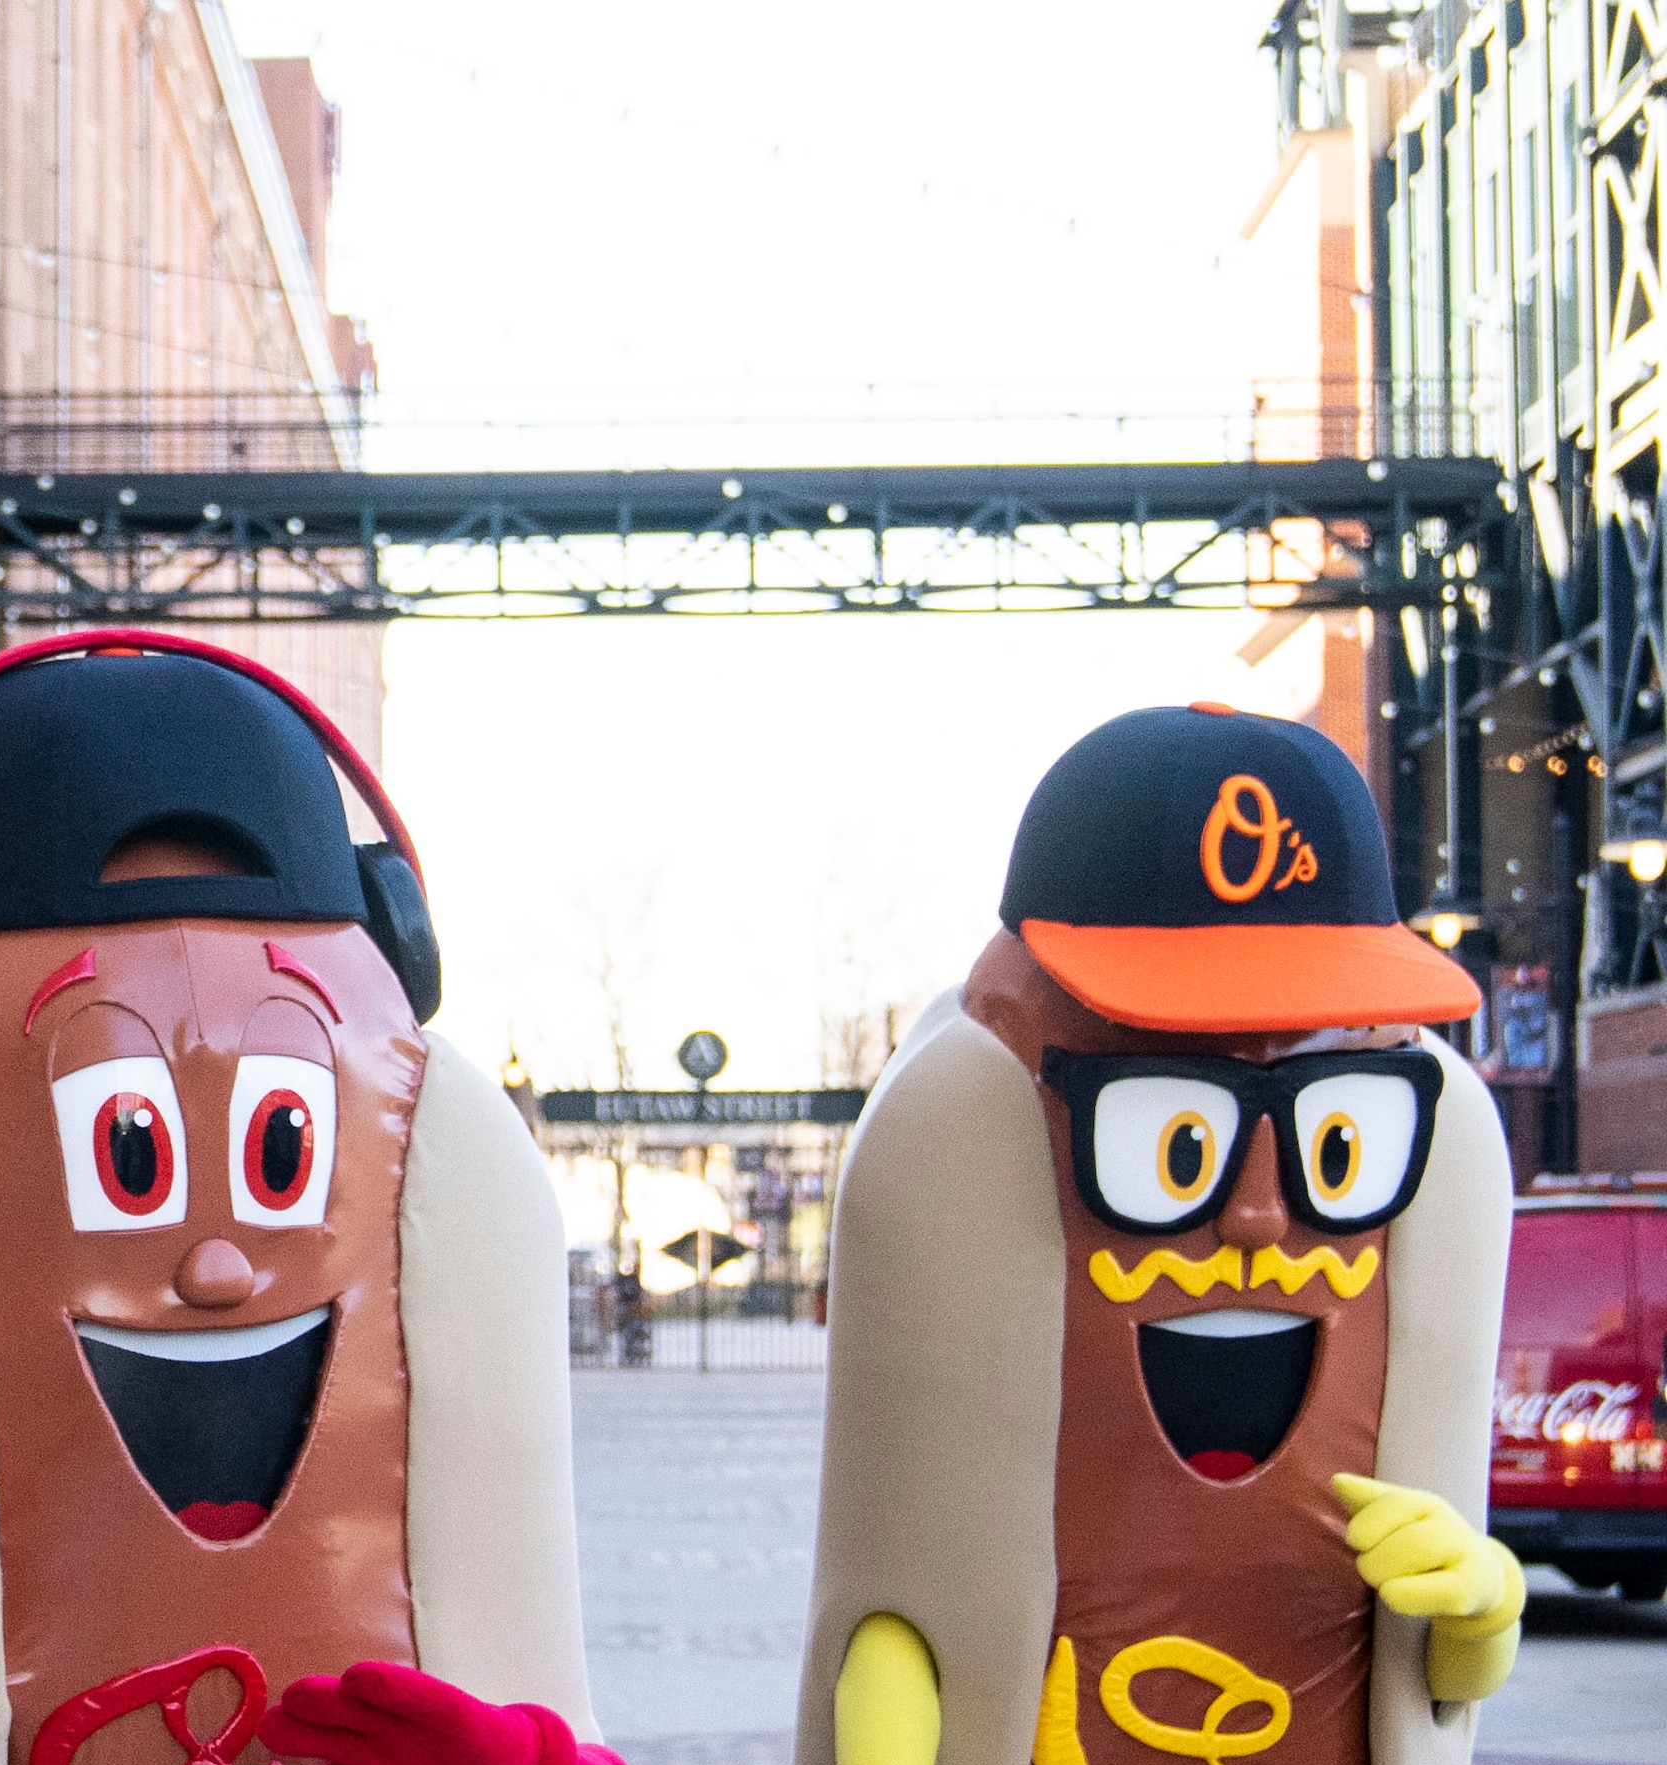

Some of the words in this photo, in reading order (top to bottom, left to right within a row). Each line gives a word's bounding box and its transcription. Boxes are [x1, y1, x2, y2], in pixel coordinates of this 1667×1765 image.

[1199, 773, 1319, 903] O's
[595, 1093, 696, 1122] EUTAW
[701, 1093, 812, 1122] STREET
